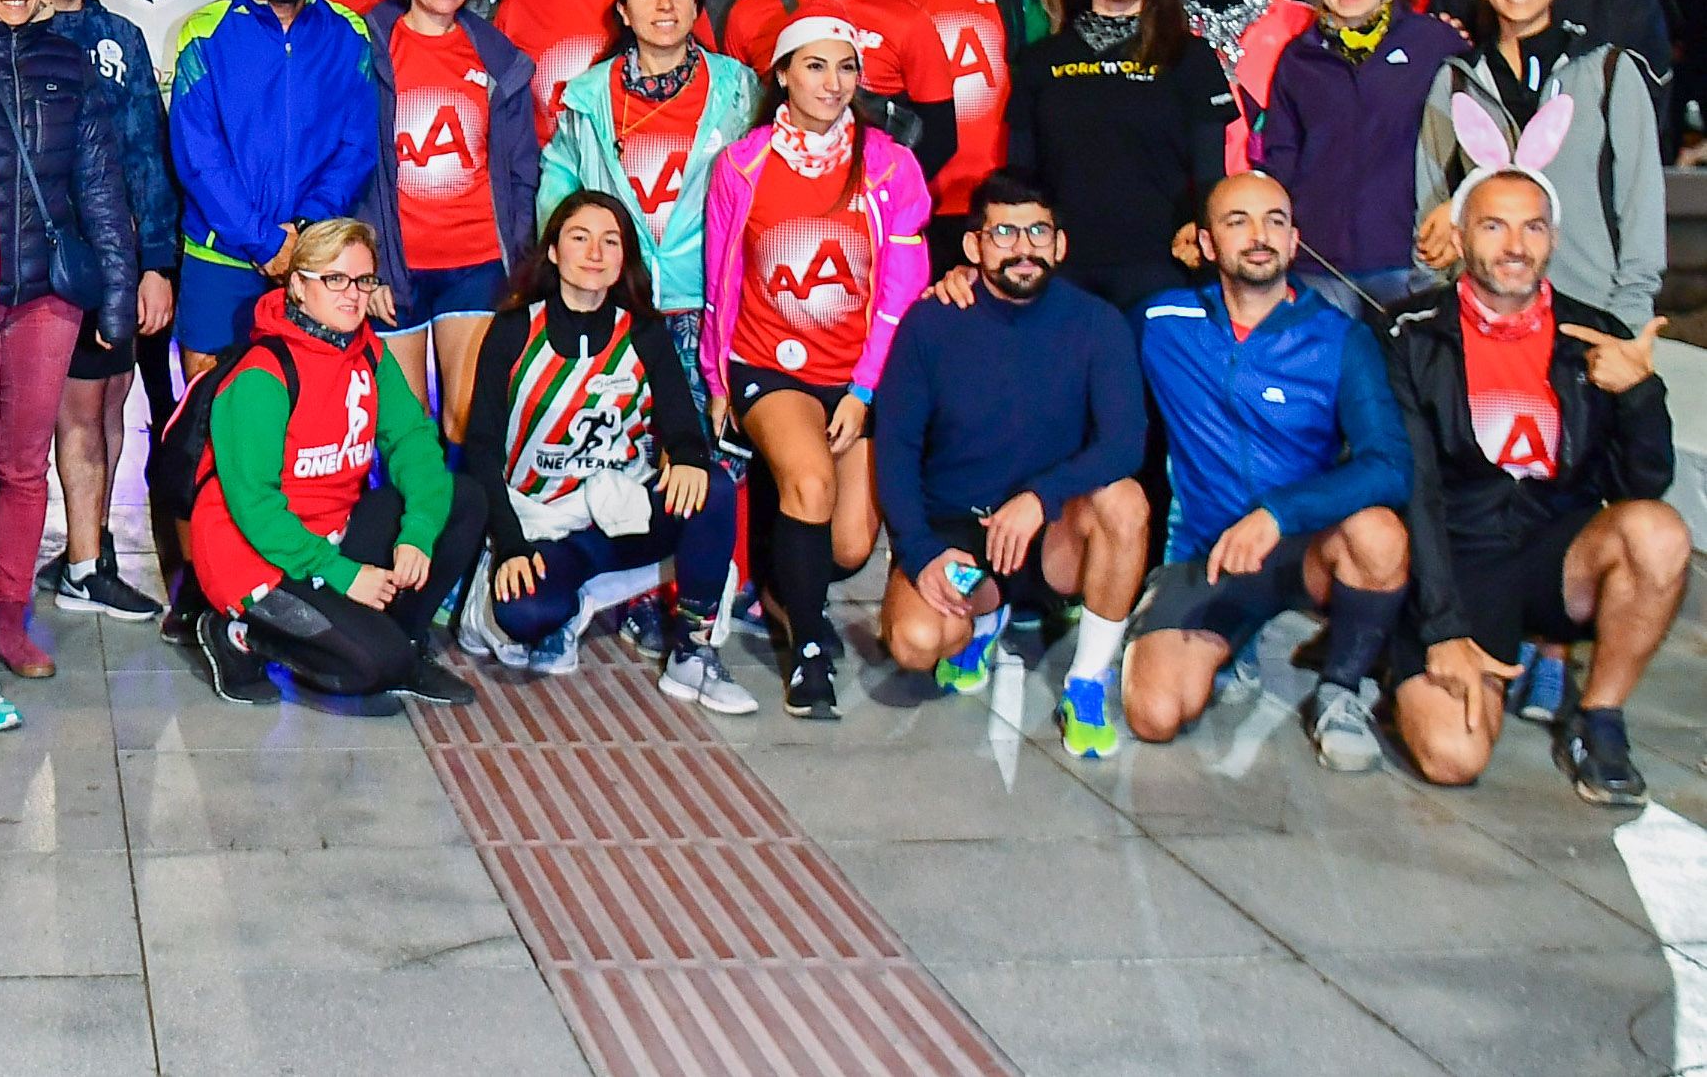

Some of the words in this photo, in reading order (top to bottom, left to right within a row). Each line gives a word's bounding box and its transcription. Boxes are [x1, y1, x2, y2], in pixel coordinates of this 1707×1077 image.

[767, 240, 862, 300] AA
[294, 453, 337, 478] ONE
[536, 455, 564, 470] ONE
